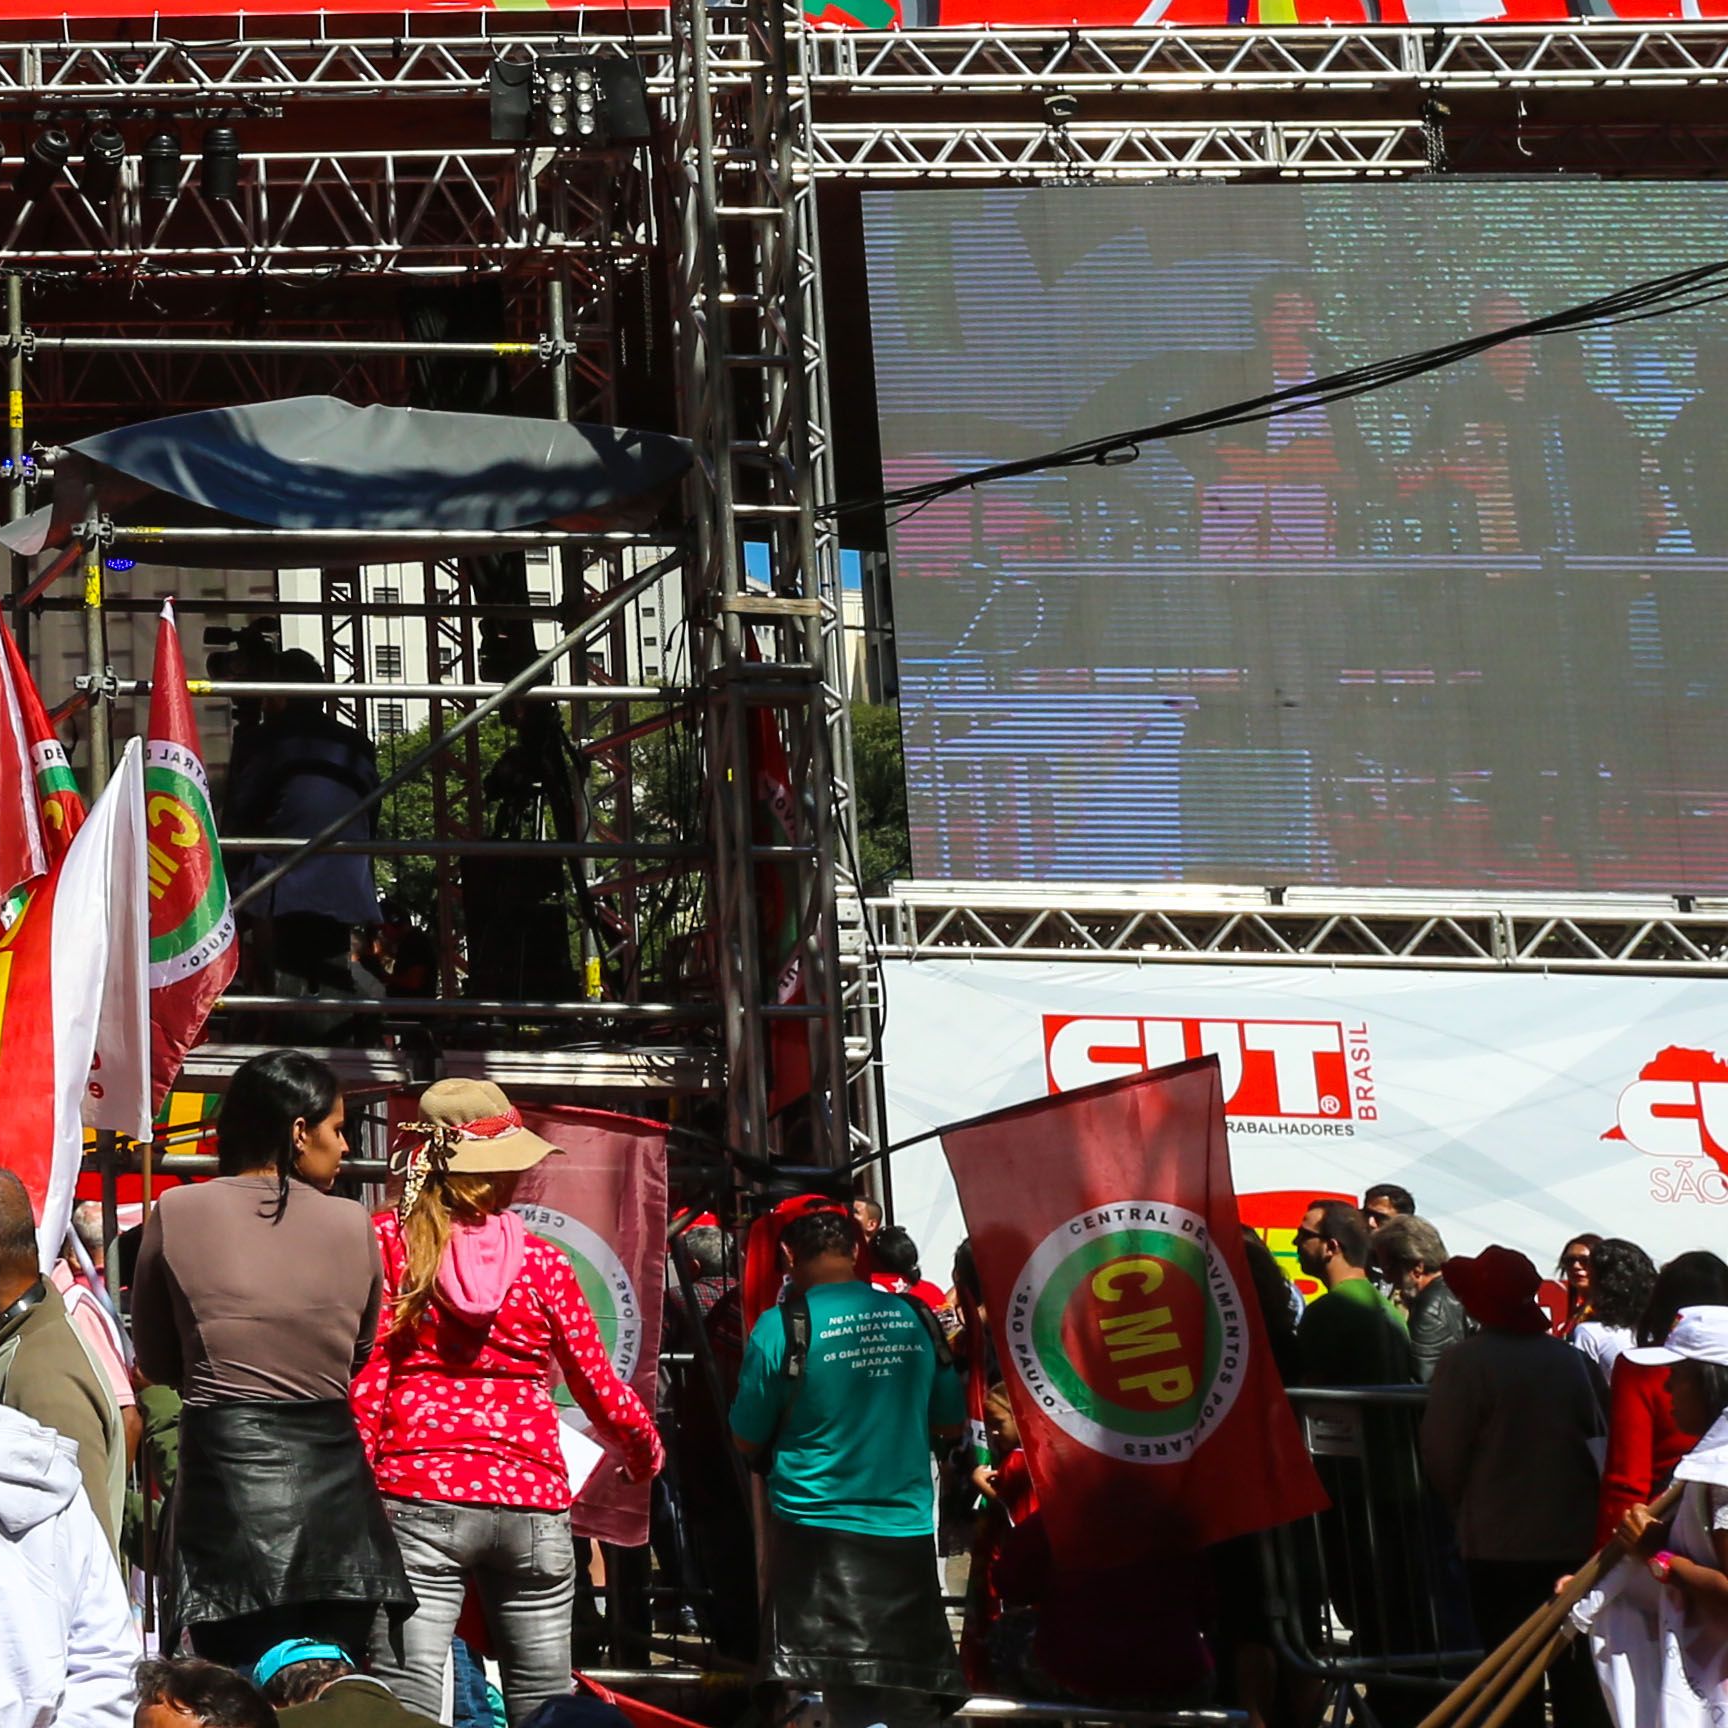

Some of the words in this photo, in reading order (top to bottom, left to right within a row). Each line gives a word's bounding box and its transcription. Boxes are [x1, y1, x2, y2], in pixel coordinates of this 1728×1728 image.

[1049, 1017, 1341, 1114] CUT
[1348, 1020, 1379, 1122] BRASIL
[1225, 1121, 1355, 1138] RABALHADORES
[1069, 1207, 1170, 1236] CENTRAL
[829, 1314, 857, 1326] NEM
[1091, 1258, 1194, 1404] CMP
